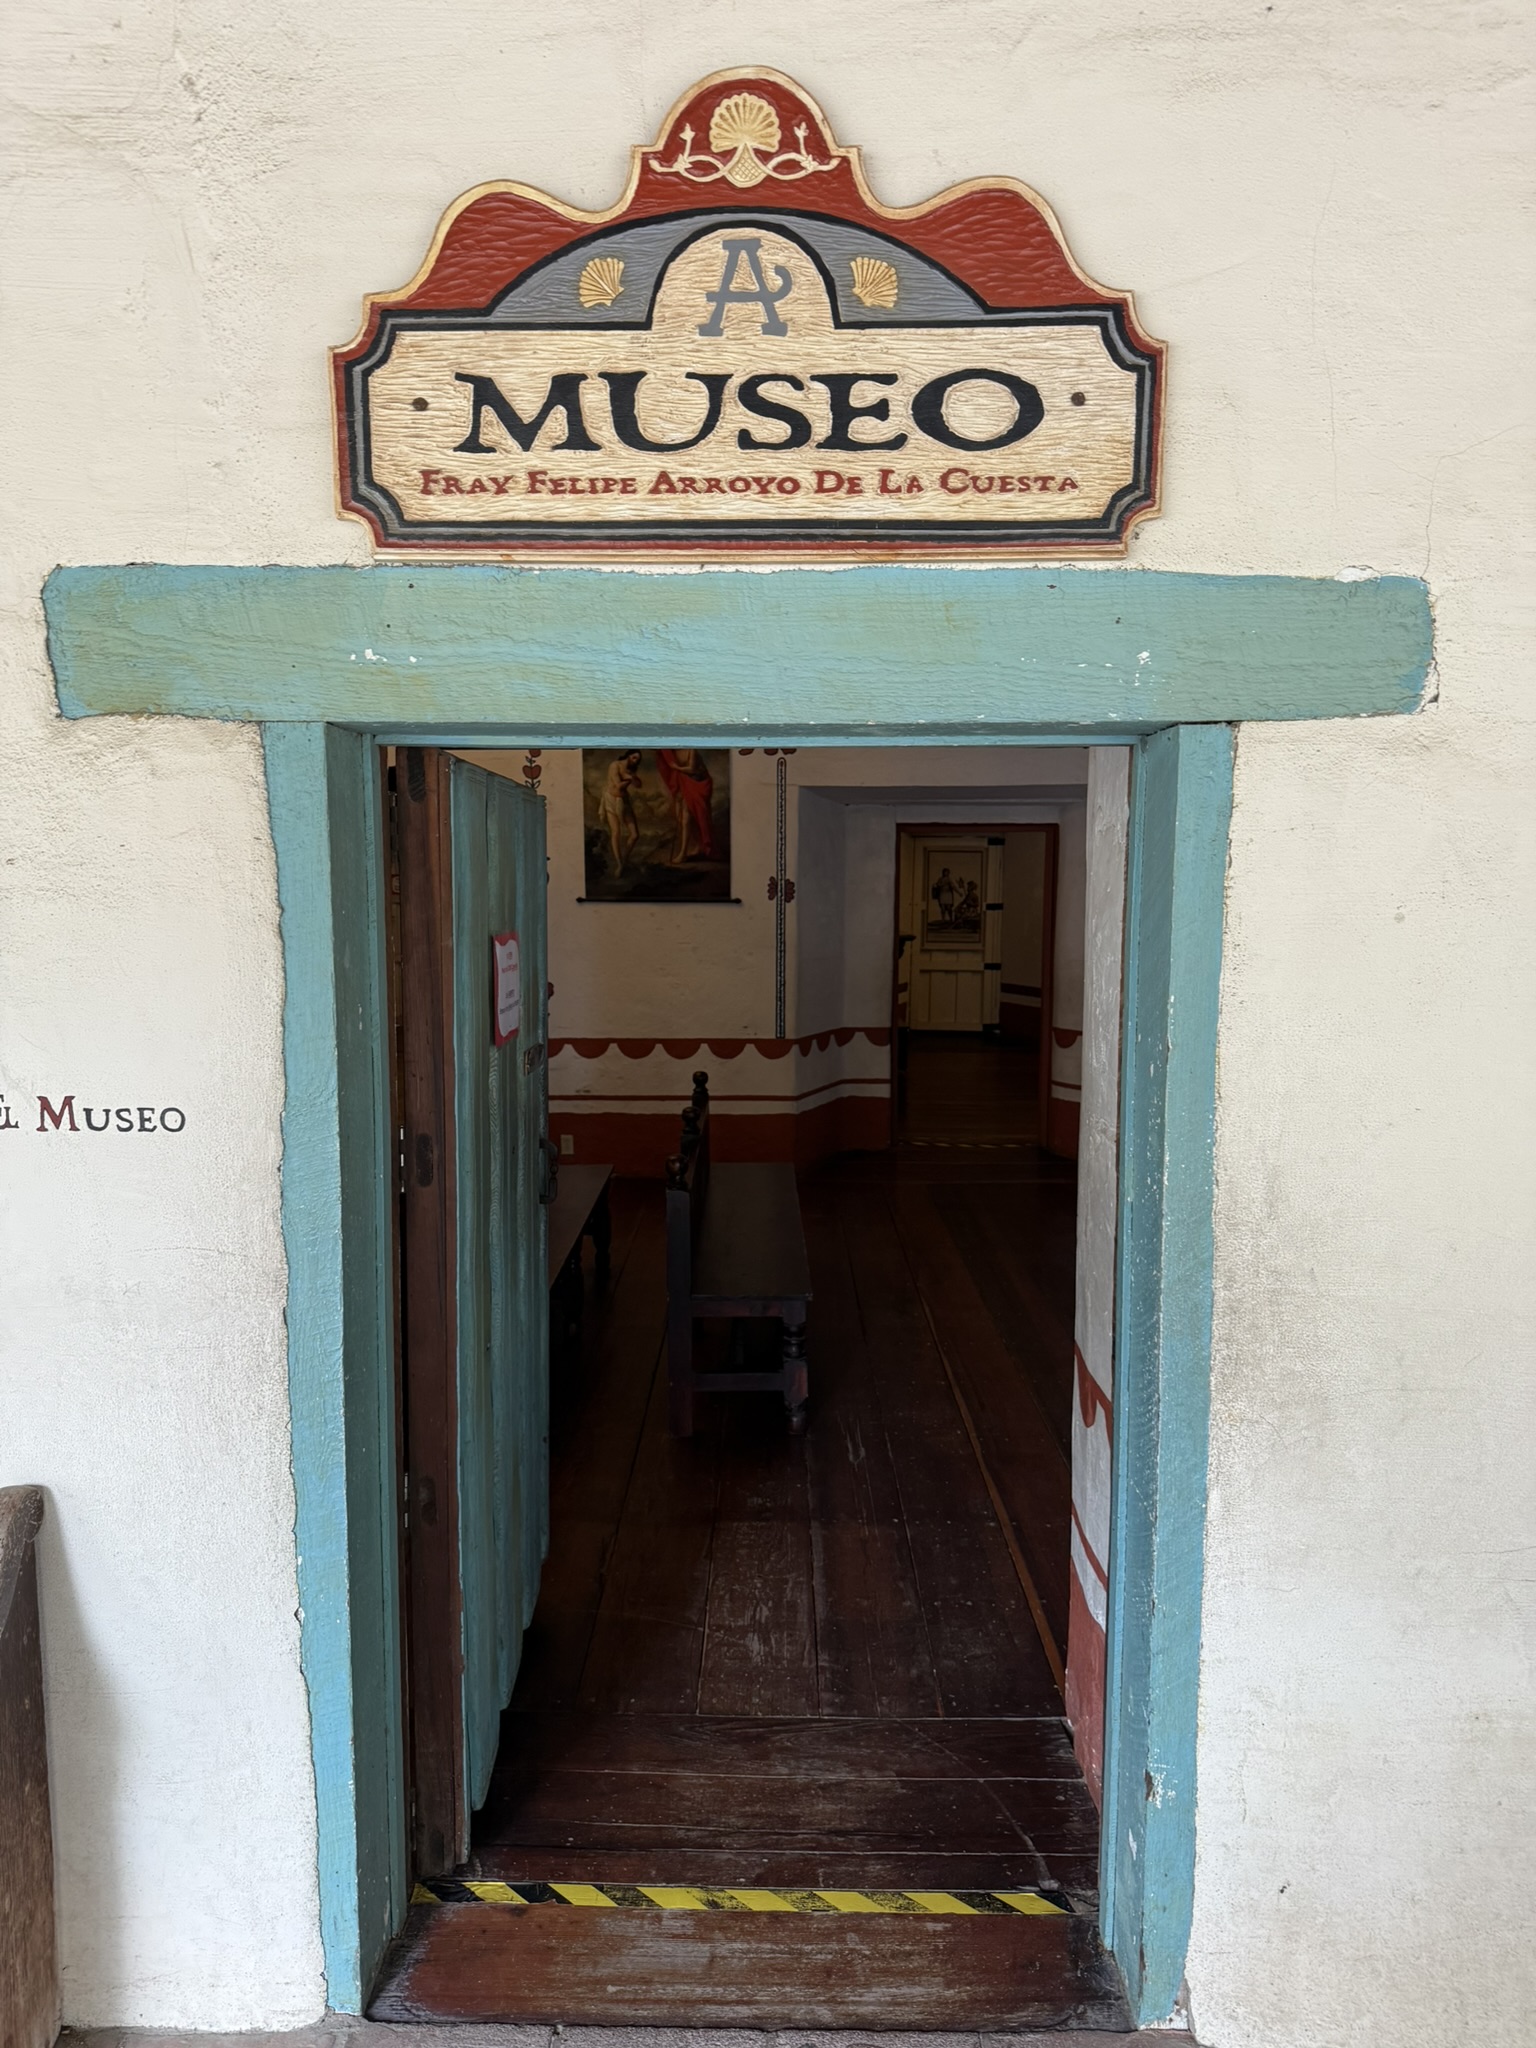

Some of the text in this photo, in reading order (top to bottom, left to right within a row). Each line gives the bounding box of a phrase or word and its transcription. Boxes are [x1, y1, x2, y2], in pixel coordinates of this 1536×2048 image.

[454, 369, 1045, 453] MUSEO
[419, 468, 1079, 496] FRAY FELIPE ARROYO DE LA CUESTA
[36, 1096, 186, 1132] MUSEO
